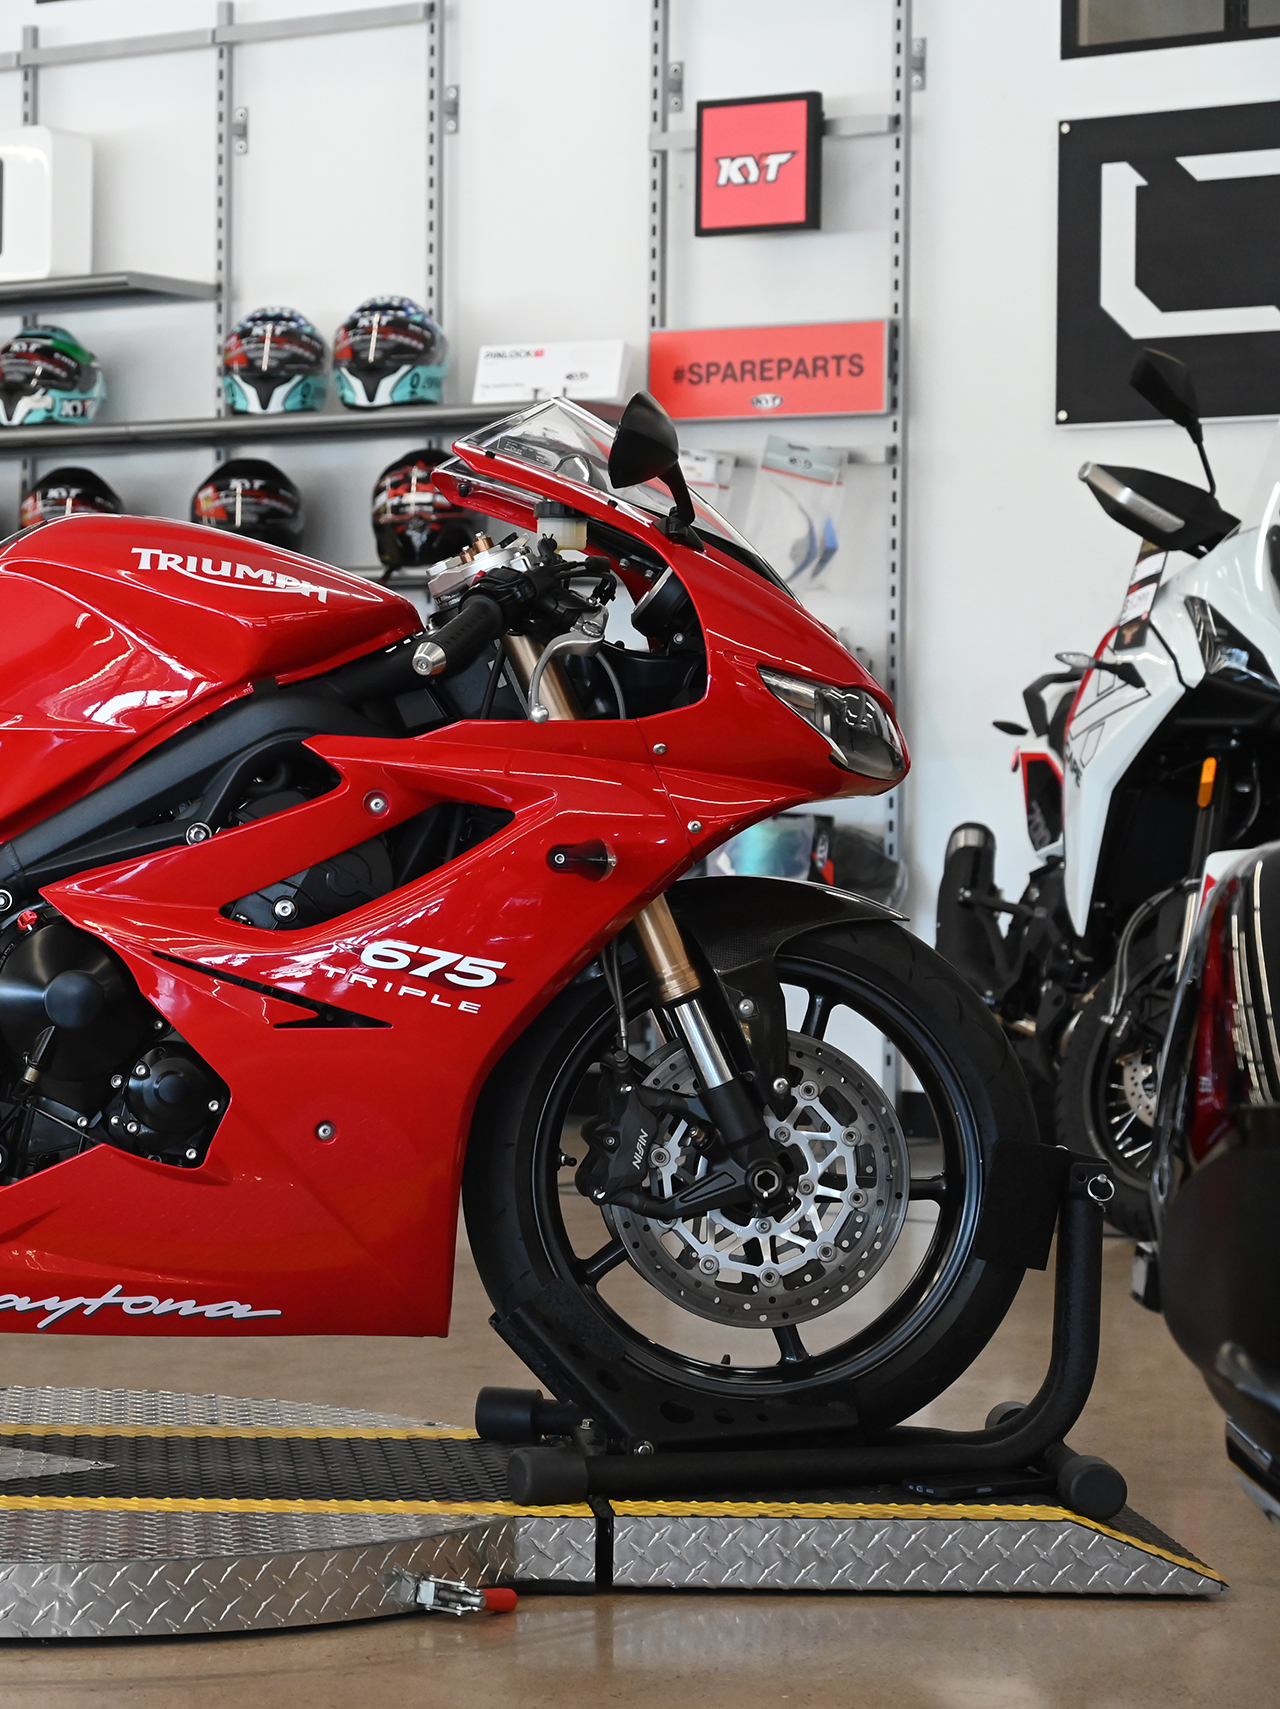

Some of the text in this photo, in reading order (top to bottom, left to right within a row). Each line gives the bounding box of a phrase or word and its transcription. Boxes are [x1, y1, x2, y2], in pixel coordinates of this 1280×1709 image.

[715, 151, 797, 187] KYT
[673, 353, 865, 386] #SPAREPARTS
[131, 547, 329, 604] TRIUMPH
[360, 940, 507, 988] 675
[318, 962, 482, 1014] TRIPLE
[632, 1128, 648, 1170] NISSIN
